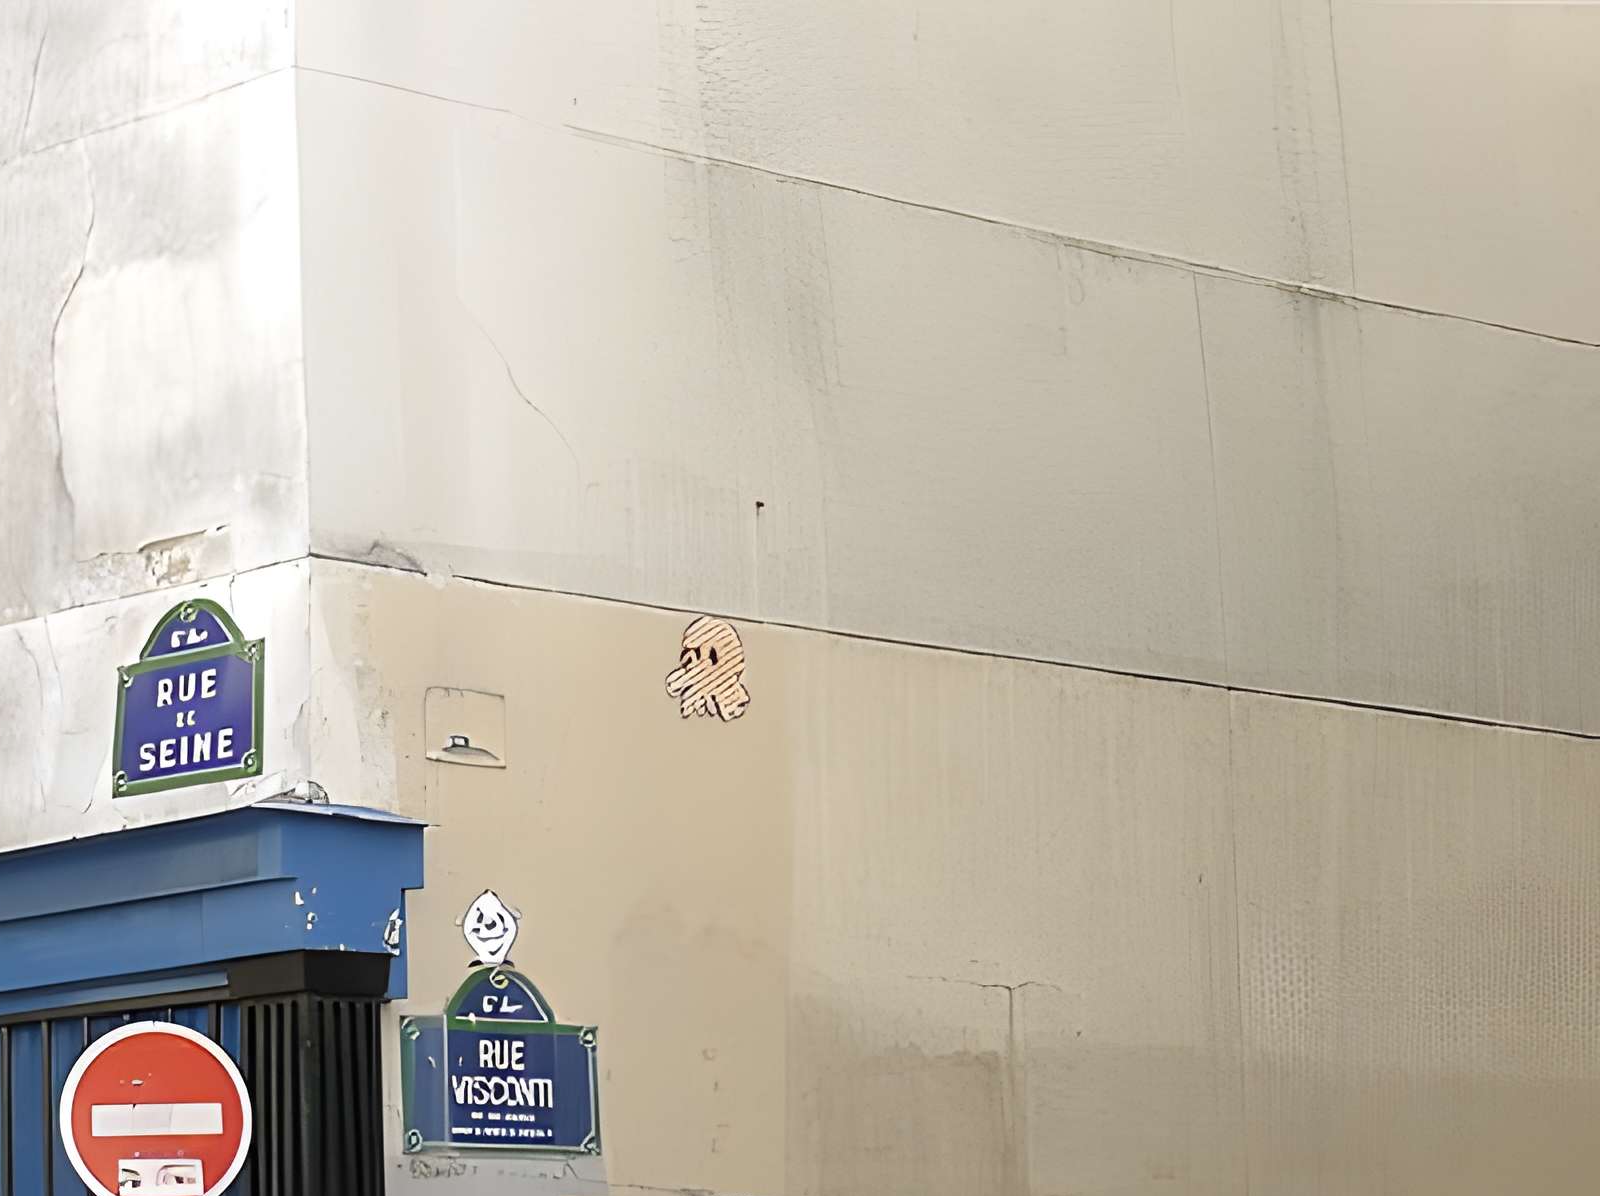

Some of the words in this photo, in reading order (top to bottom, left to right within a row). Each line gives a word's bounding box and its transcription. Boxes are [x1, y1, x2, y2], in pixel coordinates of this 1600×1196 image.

[156, 668, 217, 708] RUE
[138, 727, 234, 772] SEINE
[479, 1039, 525, 1071] RUE
